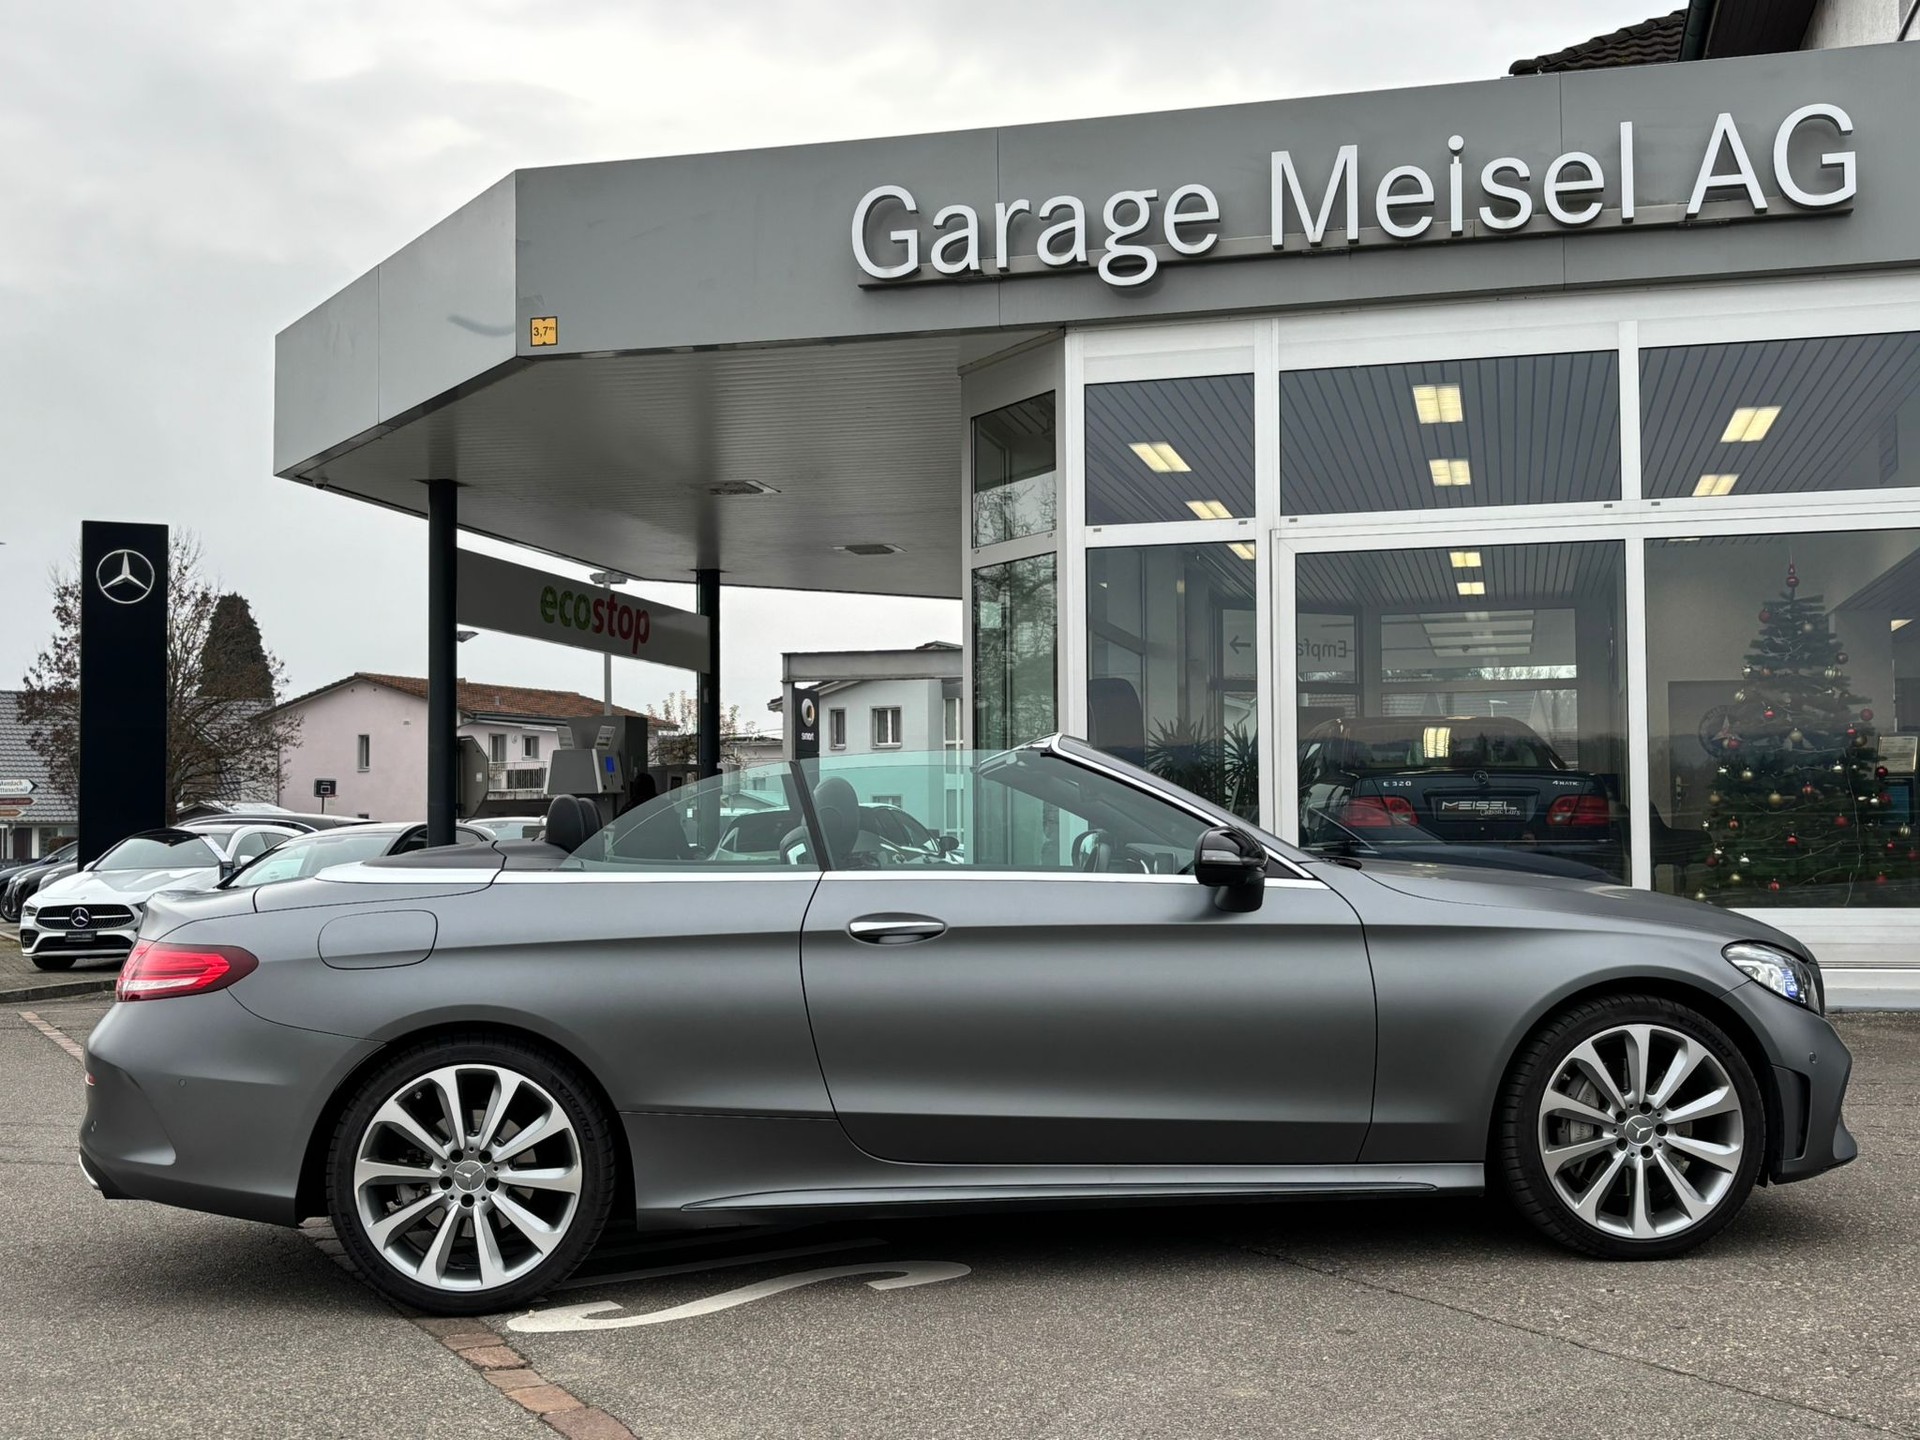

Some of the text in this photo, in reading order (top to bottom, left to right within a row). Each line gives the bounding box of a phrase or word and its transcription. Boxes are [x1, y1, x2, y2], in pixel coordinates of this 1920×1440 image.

[851, 103, 1856, 286] Garage Meisel AG
[540, 585, 650, 654] ecostop
[801, 732, 815, 741] smart
[1442, 801, 1517, 810] MEISEL
